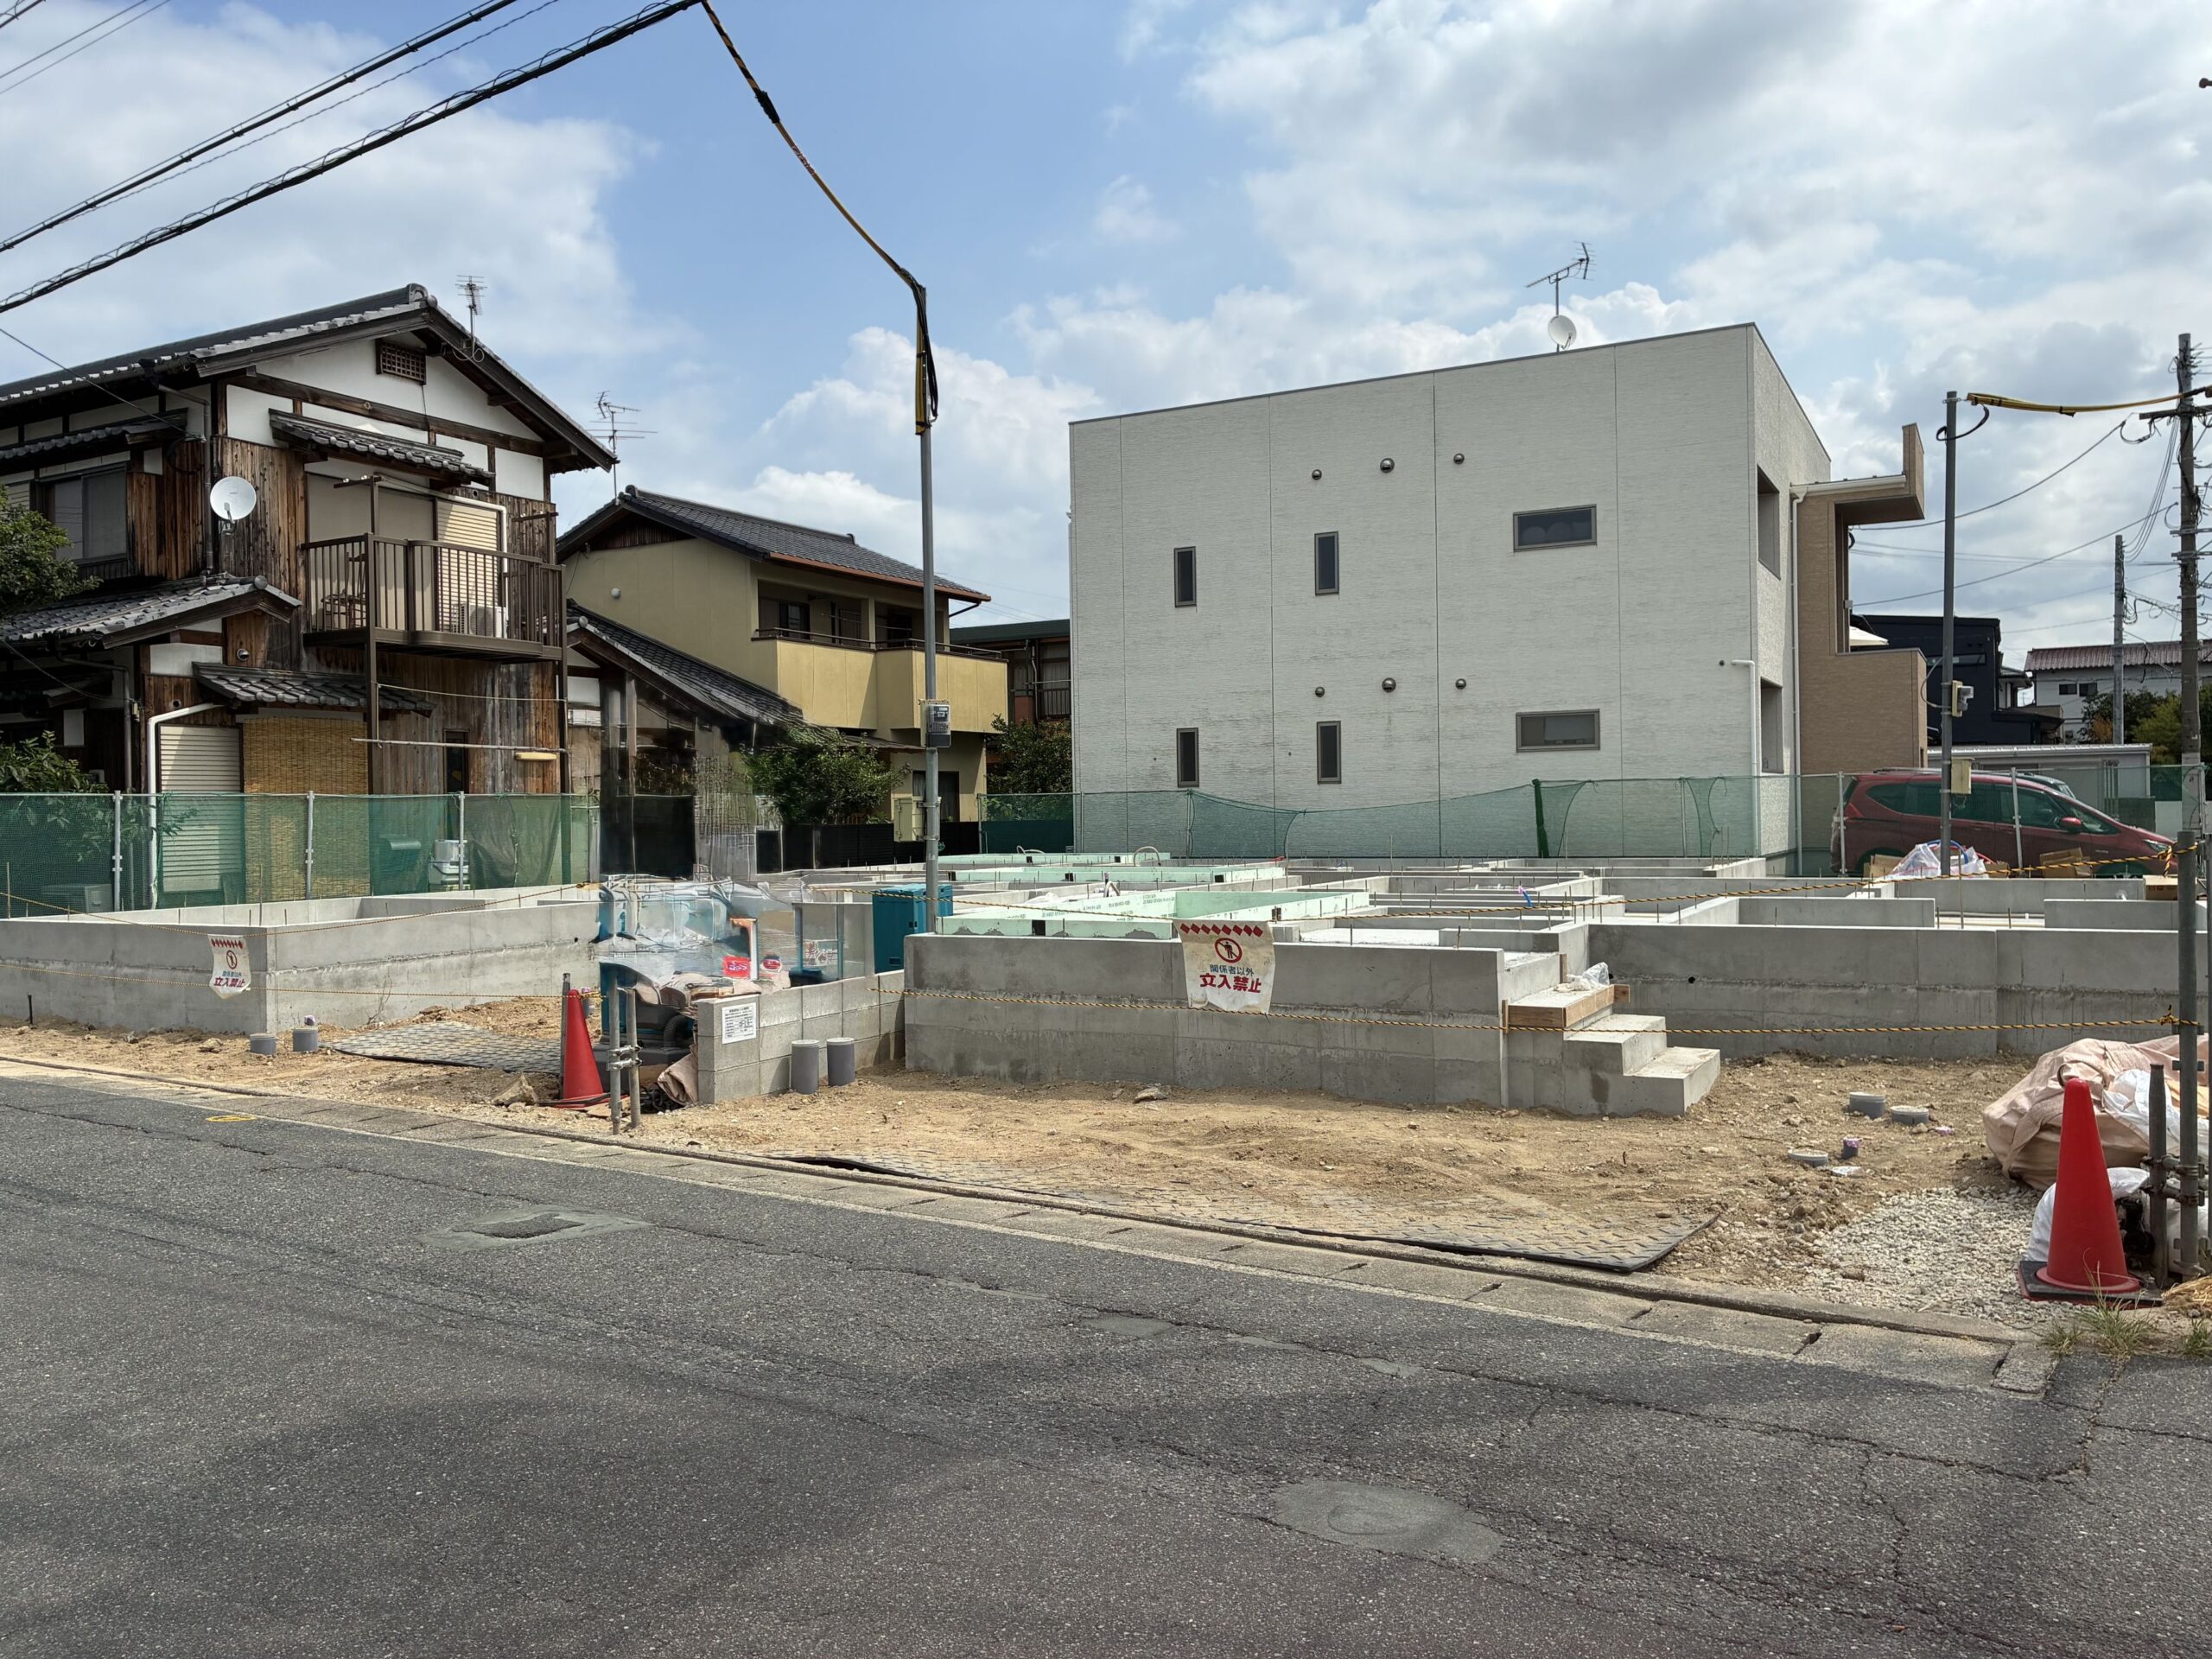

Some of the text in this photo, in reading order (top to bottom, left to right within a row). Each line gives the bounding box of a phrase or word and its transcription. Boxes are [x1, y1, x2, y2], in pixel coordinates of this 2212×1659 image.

[1210, 964, 1255, 976] 関係者以外
[214, 976, 245, 988] 立入禁止
[1199, 973, 1262, 993] 立入禁止
